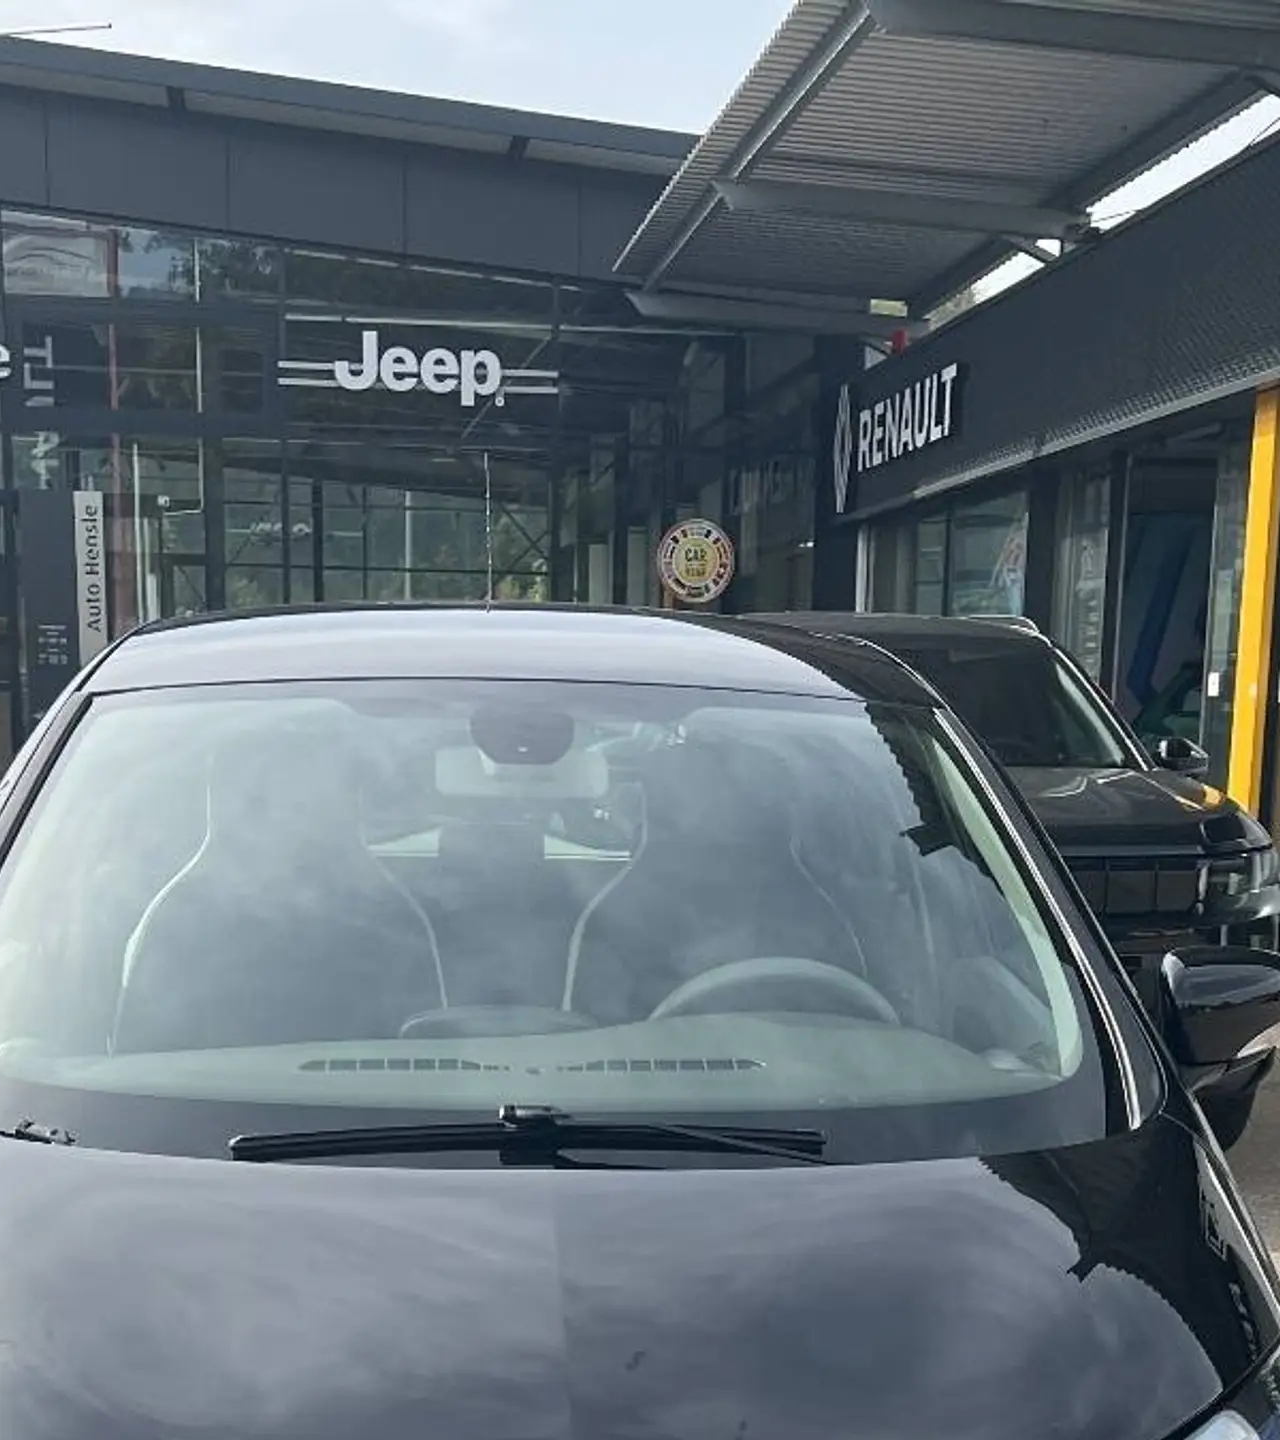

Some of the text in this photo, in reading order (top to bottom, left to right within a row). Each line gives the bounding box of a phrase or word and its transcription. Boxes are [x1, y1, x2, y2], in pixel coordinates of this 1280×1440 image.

[334, 330, 503, 406] Jeep
[857, 362, 958, 473] RENAULT
[81, 504, 102, 633] Auto Hensle
